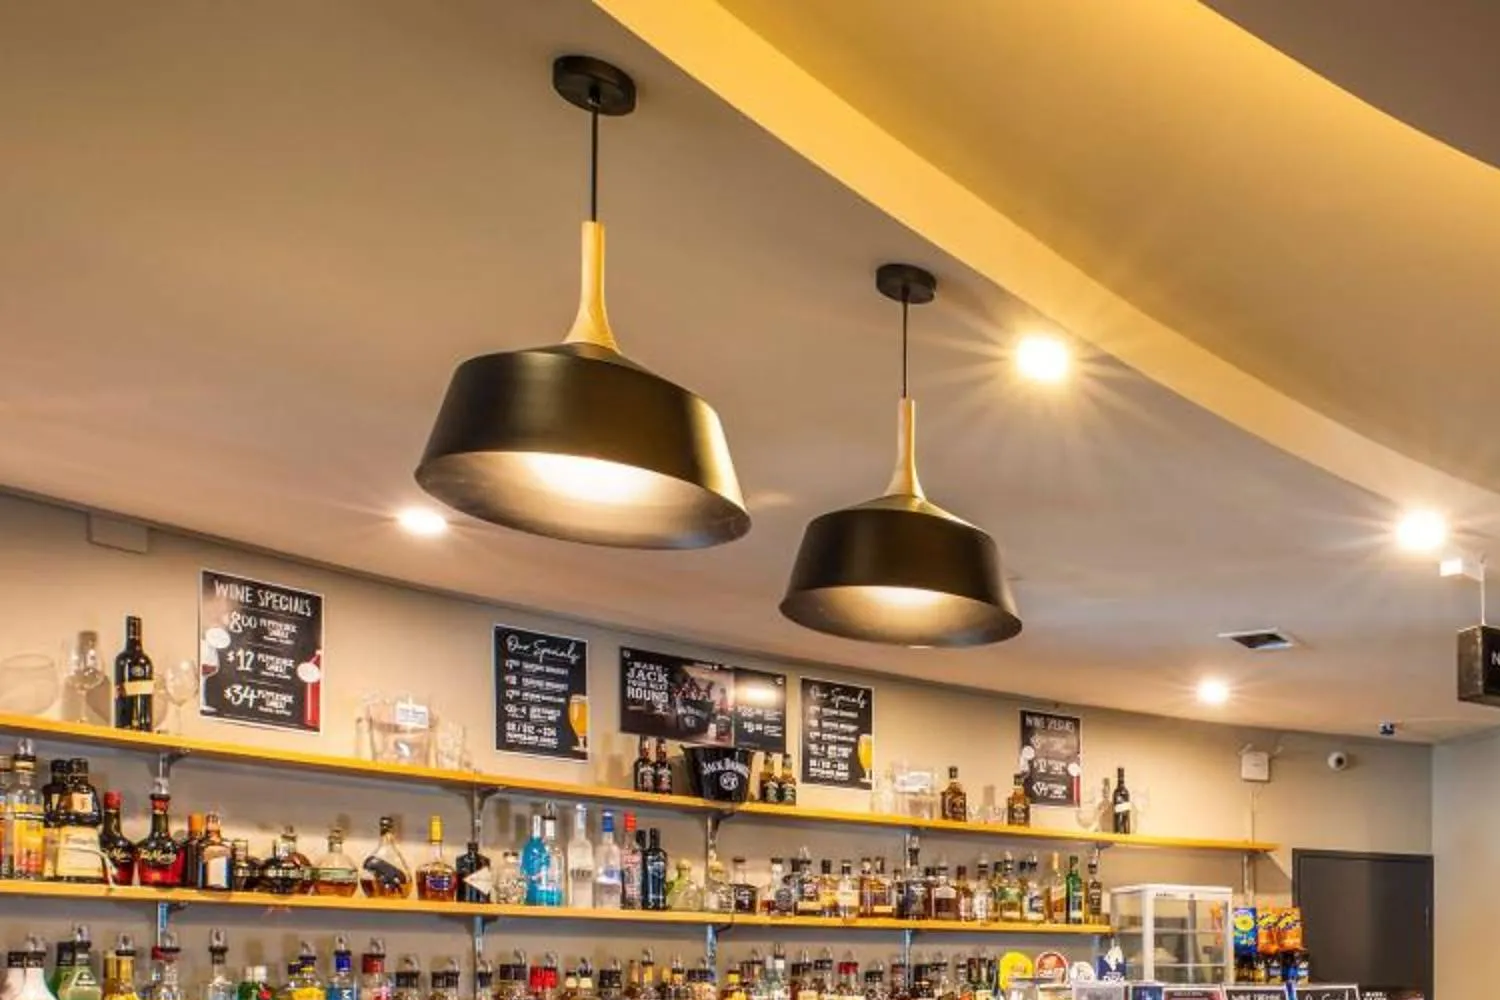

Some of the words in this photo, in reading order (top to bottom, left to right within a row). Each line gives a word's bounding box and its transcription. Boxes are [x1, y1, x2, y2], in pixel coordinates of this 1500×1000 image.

[214, 579, 253, 603] WINE
[257, 590, 313, 617] SPECIALS
[226, 648, 255, 671] $12
[626, 668, 669, 684] JACK
